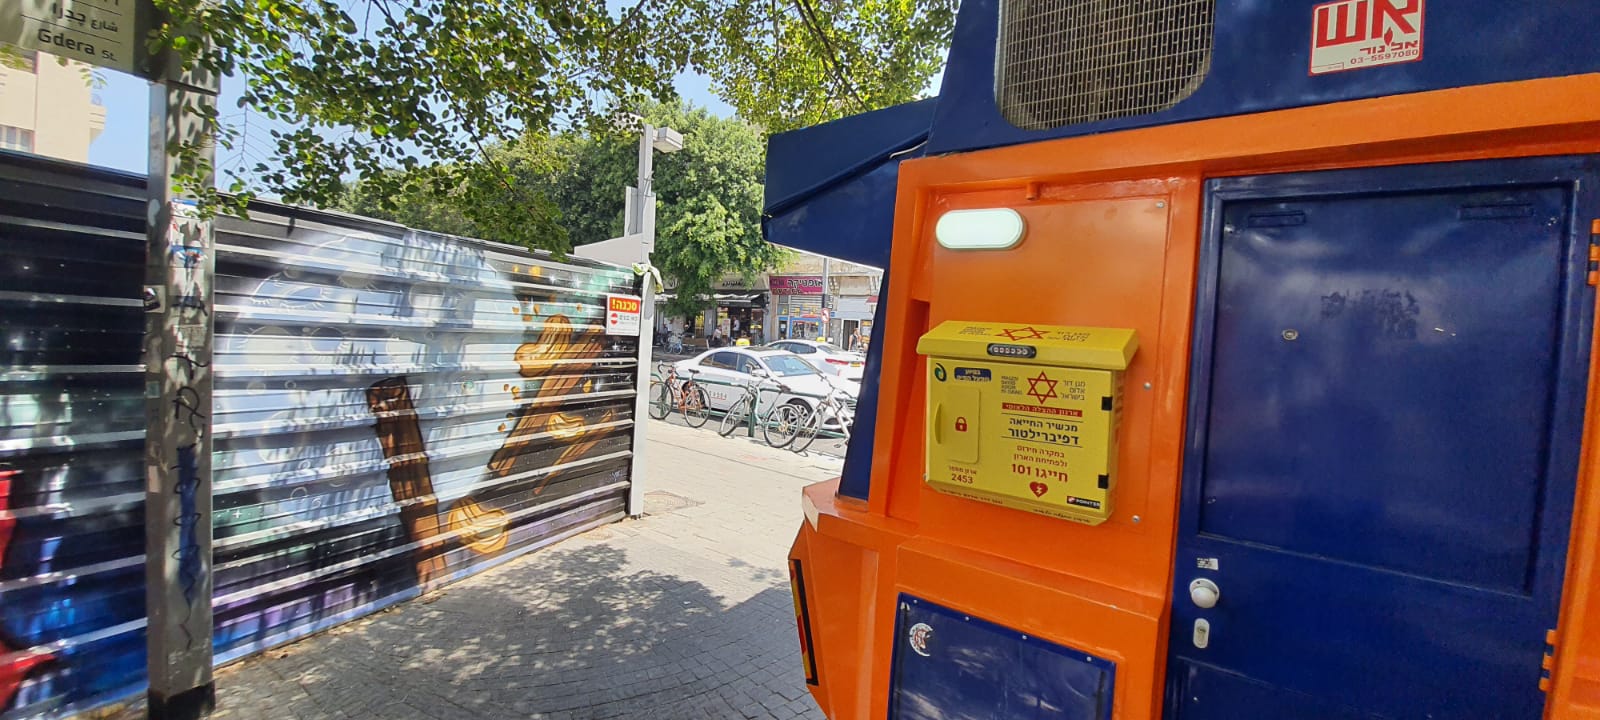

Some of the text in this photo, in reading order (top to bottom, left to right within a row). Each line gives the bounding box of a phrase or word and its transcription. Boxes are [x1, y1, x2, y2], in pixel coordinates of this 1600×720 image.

[91, 19, 118, 32] شارع
[1316, 0, 1418, 48] אש
[37, 28, 96, 56] Gdera
[1350, 49, 1418, 64] 03-5597080
[612, 299, 637, 311] סכנה!
[1009, 418, 1078, 432] מכשיר החייאה
[1008, 428, 1079, 445] דפיברילטור
[1014, 454, 1034, 462] הארון
[1016, 445, 1065, 458] במקרה חירום
[951, 473, 974, 484] 2453
[1012, 463, 1068, 483] חייגו 101
